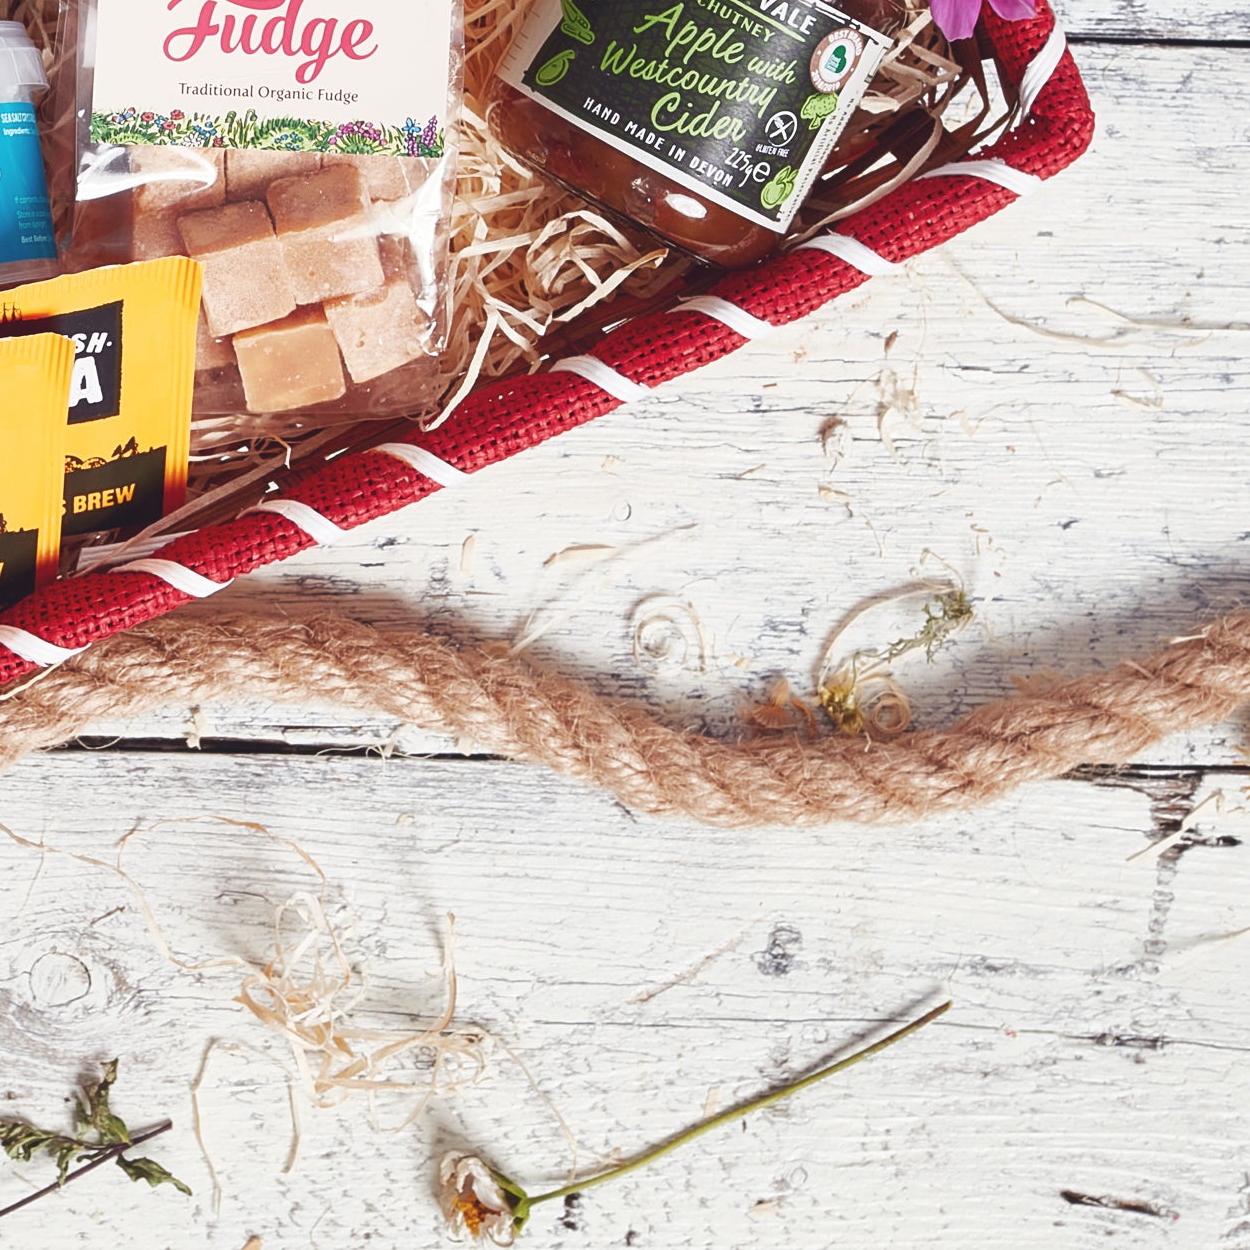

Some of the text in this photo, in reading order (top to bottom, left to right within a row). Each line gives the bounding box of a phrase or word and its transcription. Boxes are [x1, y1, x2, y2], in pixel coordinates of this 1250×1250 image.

[633, 2, 745, 65] Apple
[747, 57, 798, 85] with
[178, 82, 359, 106] Traditional Organic Fudge
[600, 40, 778, 119] Westcountry
[582, 96, 734, 188] HAND MADE IN DEVON
[650, 91, 747, 142] Cider
[776, 147, 791, 158] FREE
[73, 482, 137, 515] BREW
